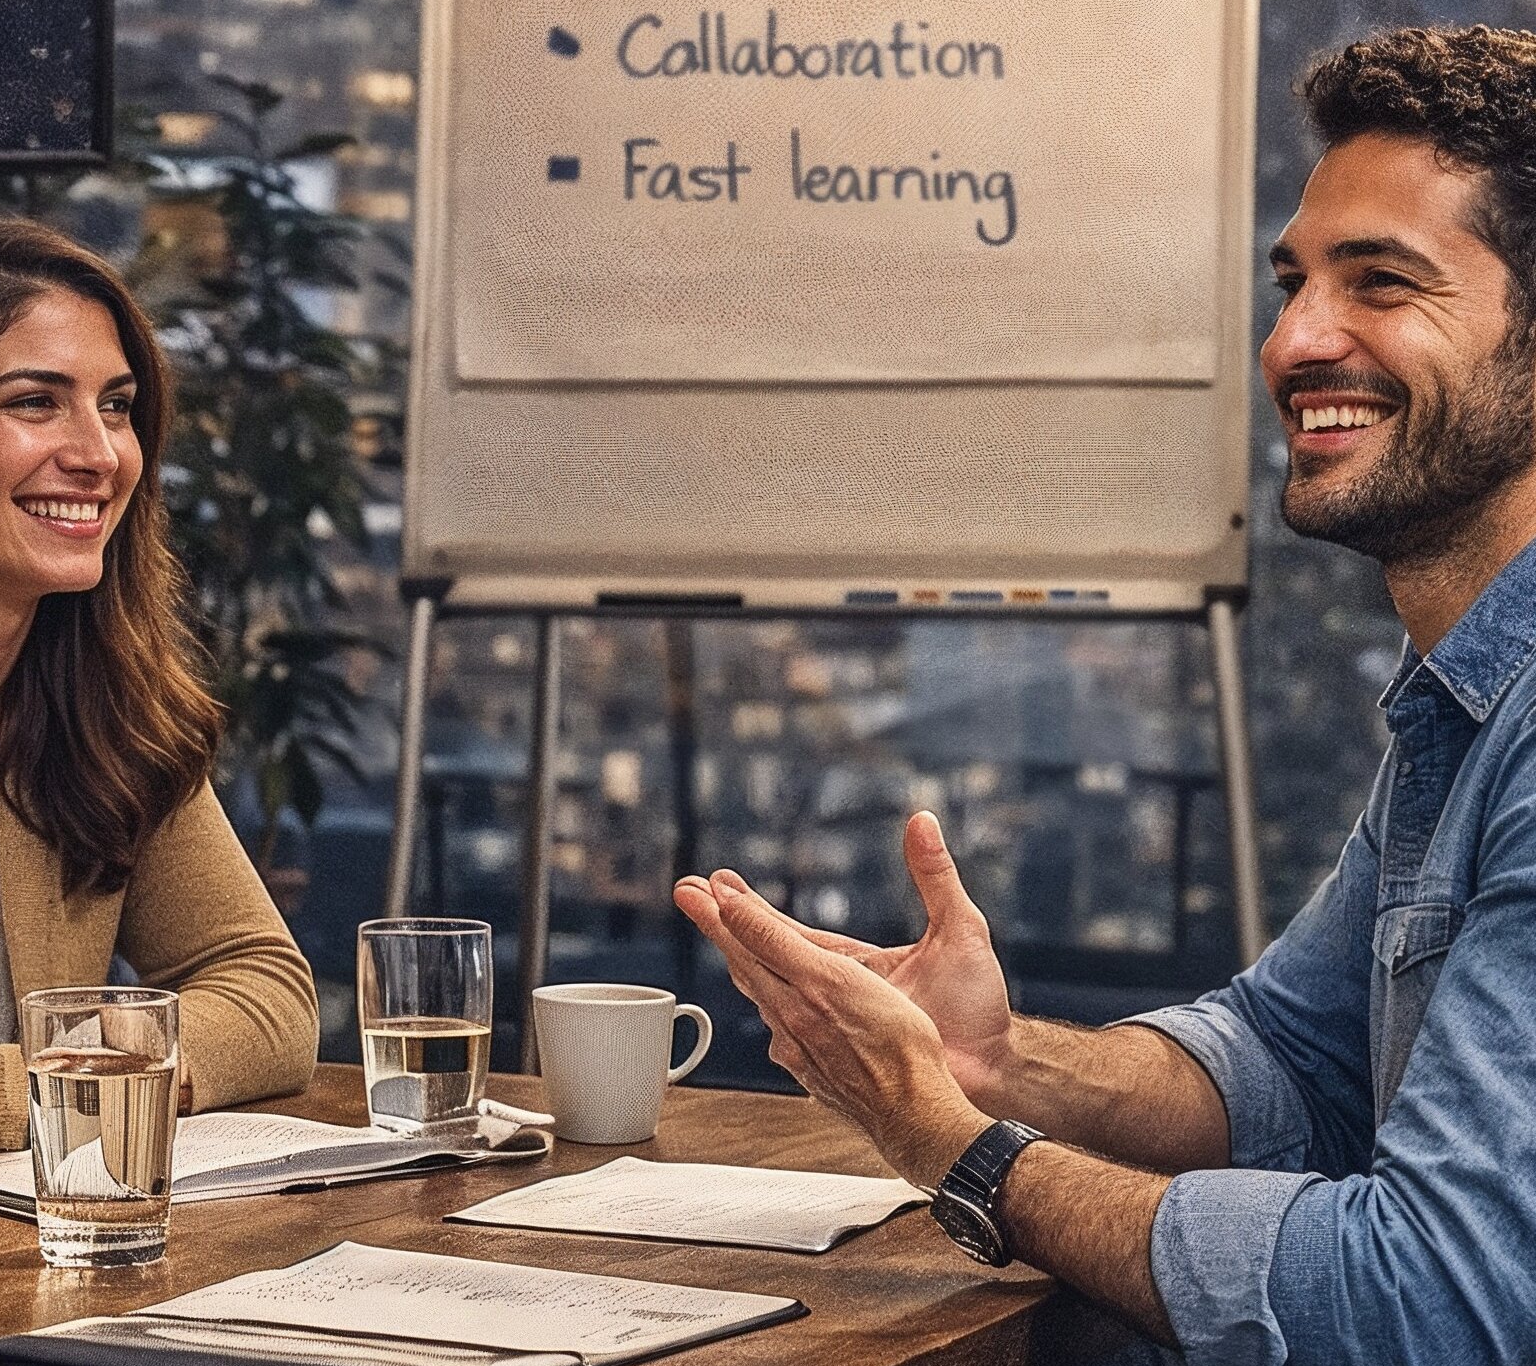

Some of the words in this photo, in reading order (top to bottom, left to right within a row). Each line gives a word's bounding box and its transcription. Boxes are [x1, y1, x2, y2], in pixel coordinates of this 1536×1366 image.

[614, 10, 1006, 82] Collaboration
[620, 135, 751, 204] Fast
[789, 128, 1020, 248] learning
